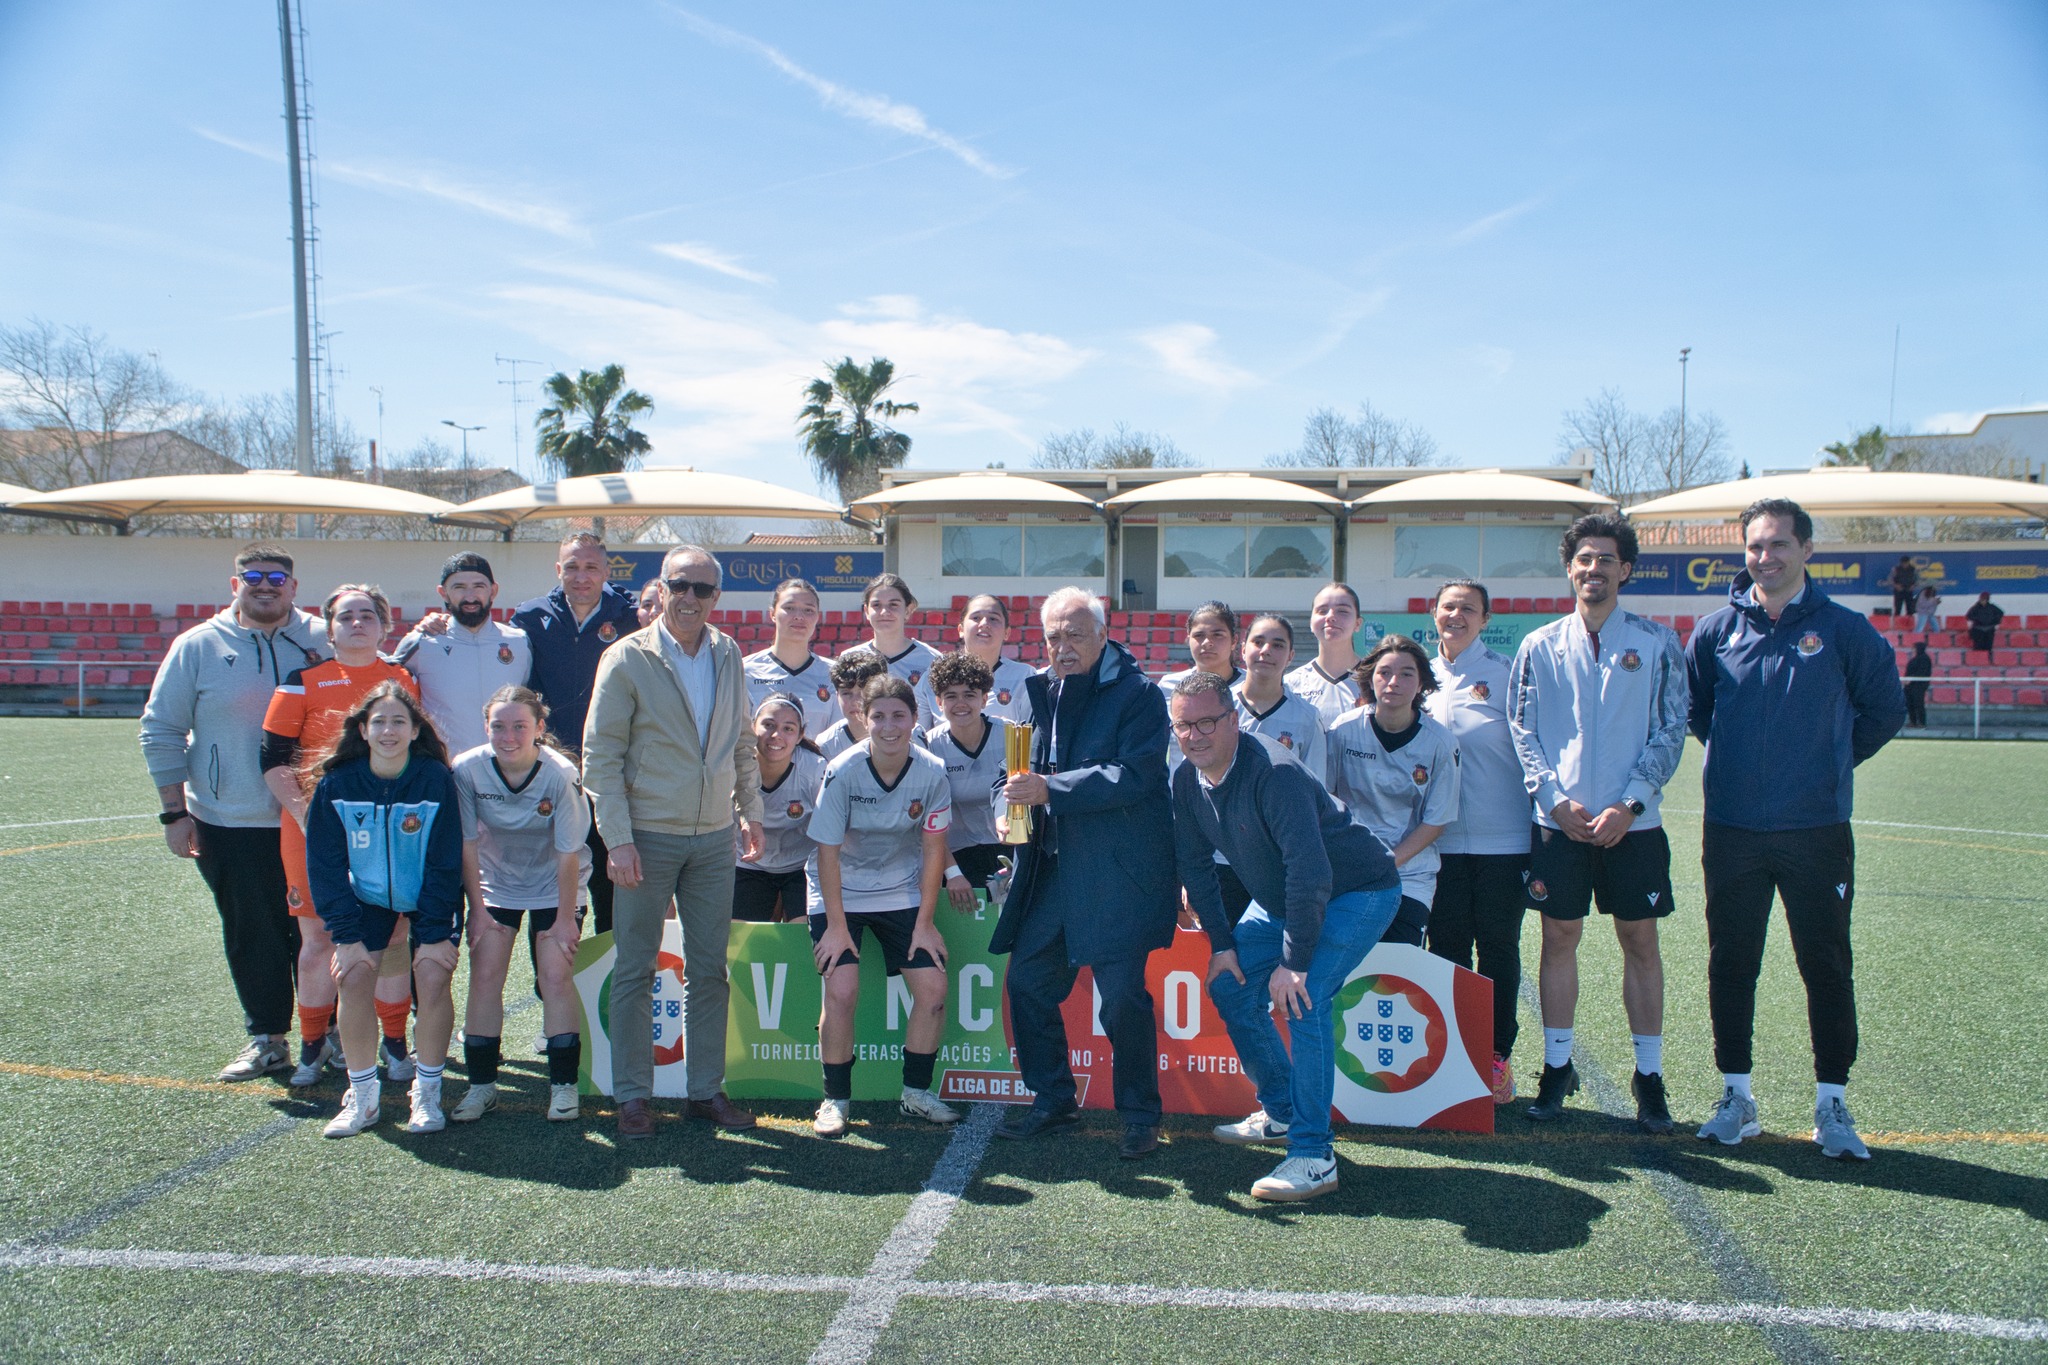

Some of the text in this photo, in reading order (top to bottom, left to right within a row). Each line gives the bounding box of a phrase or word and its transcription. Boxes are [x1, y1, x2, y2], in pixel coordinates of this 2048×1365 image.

[1345, 748, 1377, 760] macron
[927, 814, 939, 829] C
[351, 830, 371, 849] 19
[948, 1077, 987, 1095] LIGA
[990, 1079, 1010, 1096] DE
